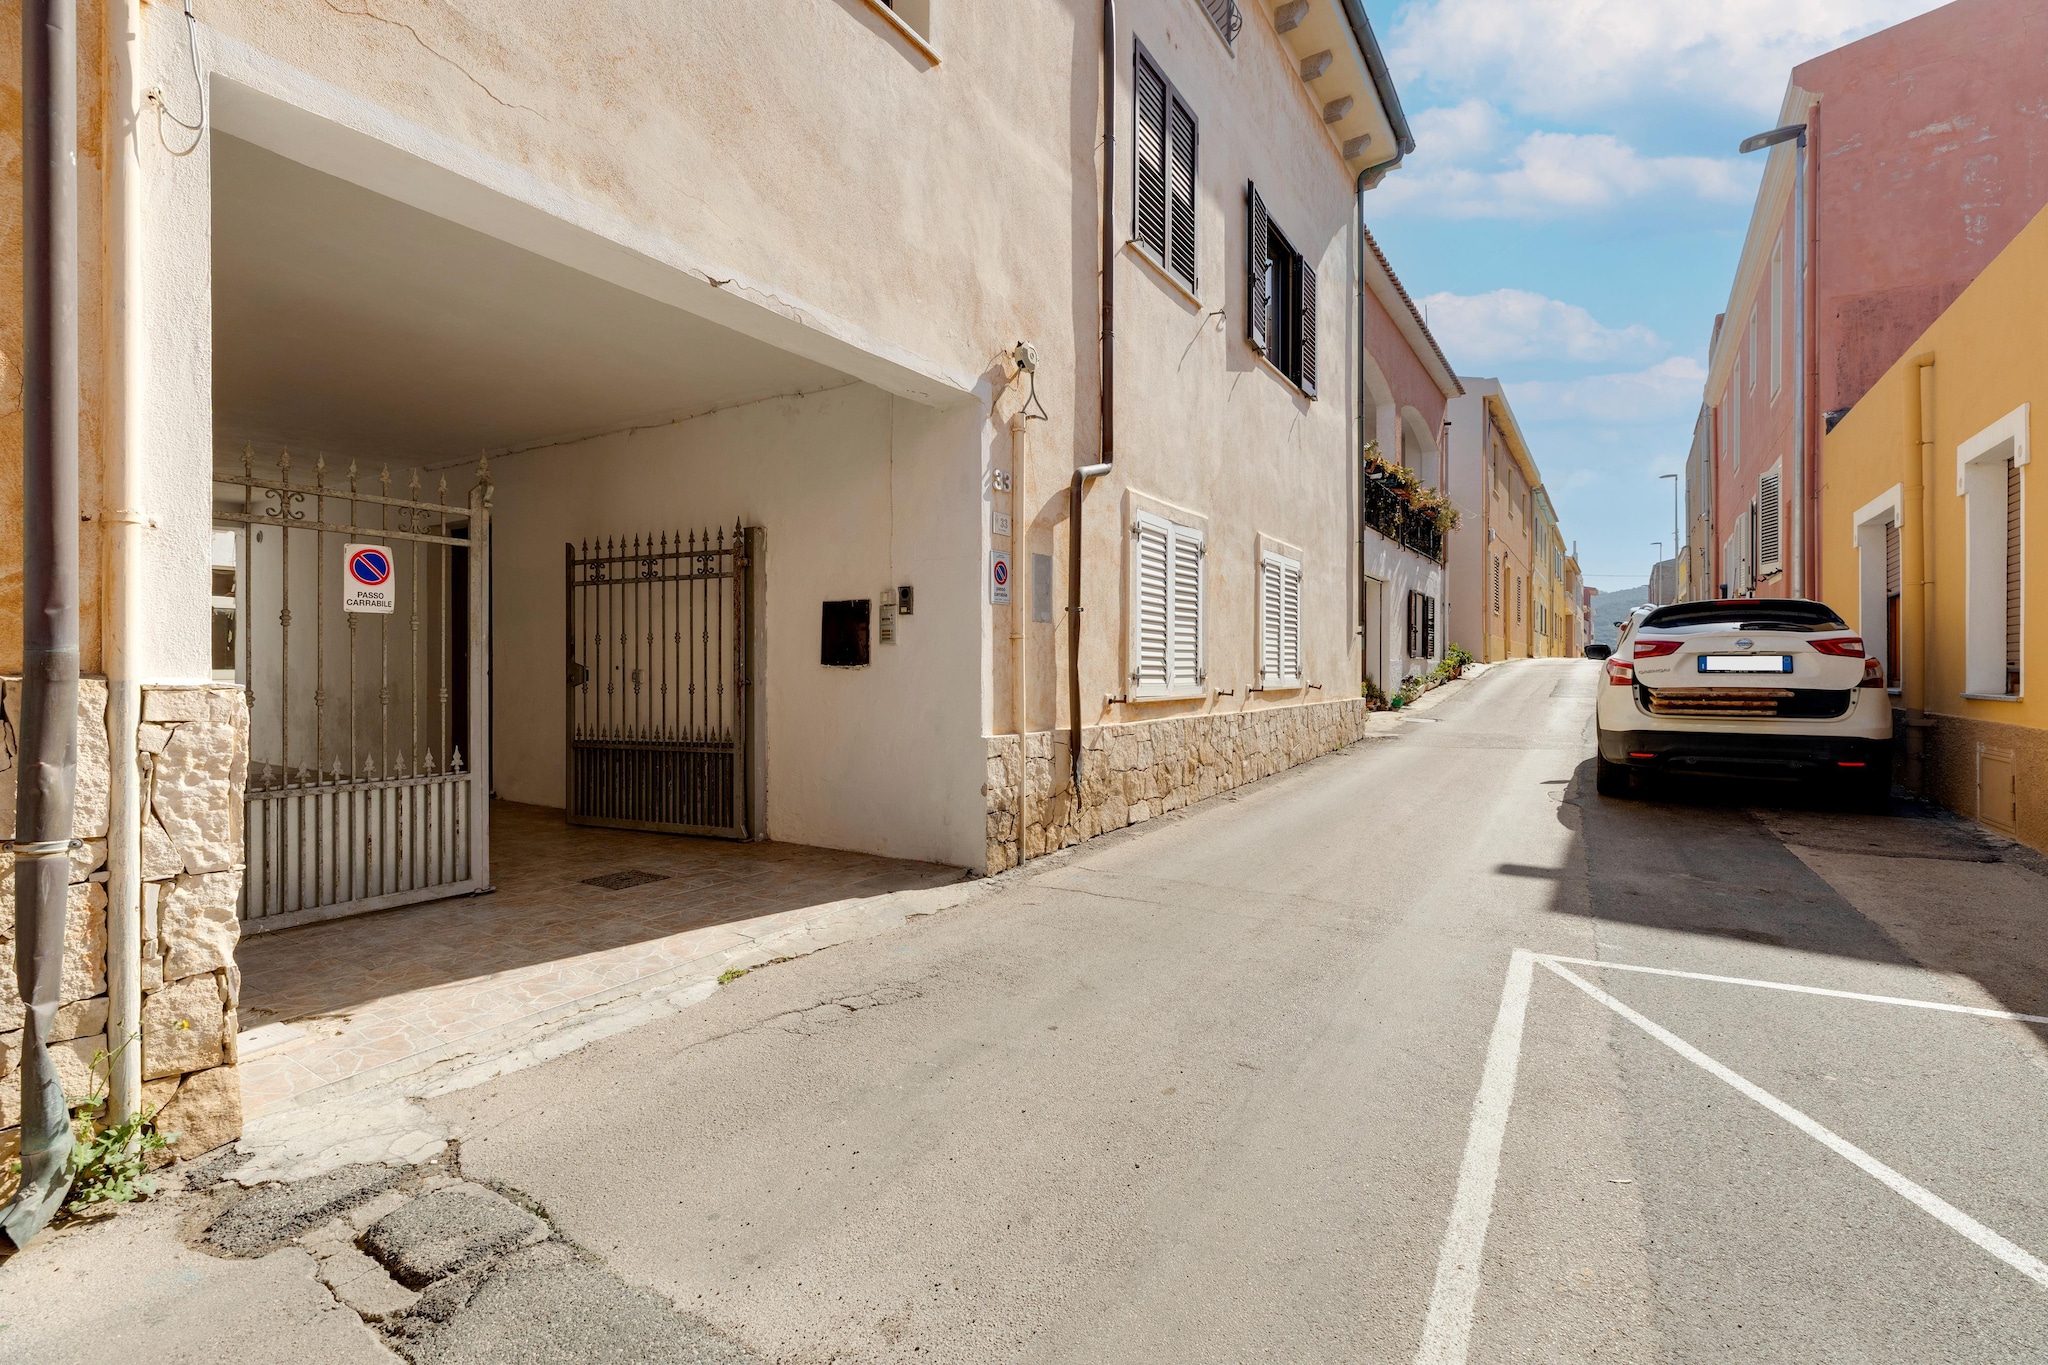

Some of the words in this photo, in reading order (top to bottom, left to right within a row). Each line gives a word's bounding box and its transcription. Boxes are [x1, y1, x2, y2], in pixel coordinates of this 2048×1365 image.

[993, 469, 1011, 492] 33
[1000, 518, 1008, 529] 33
[357, 591, 384, 599] PASSO
[346, 598, 392, 608] CARRABILE
